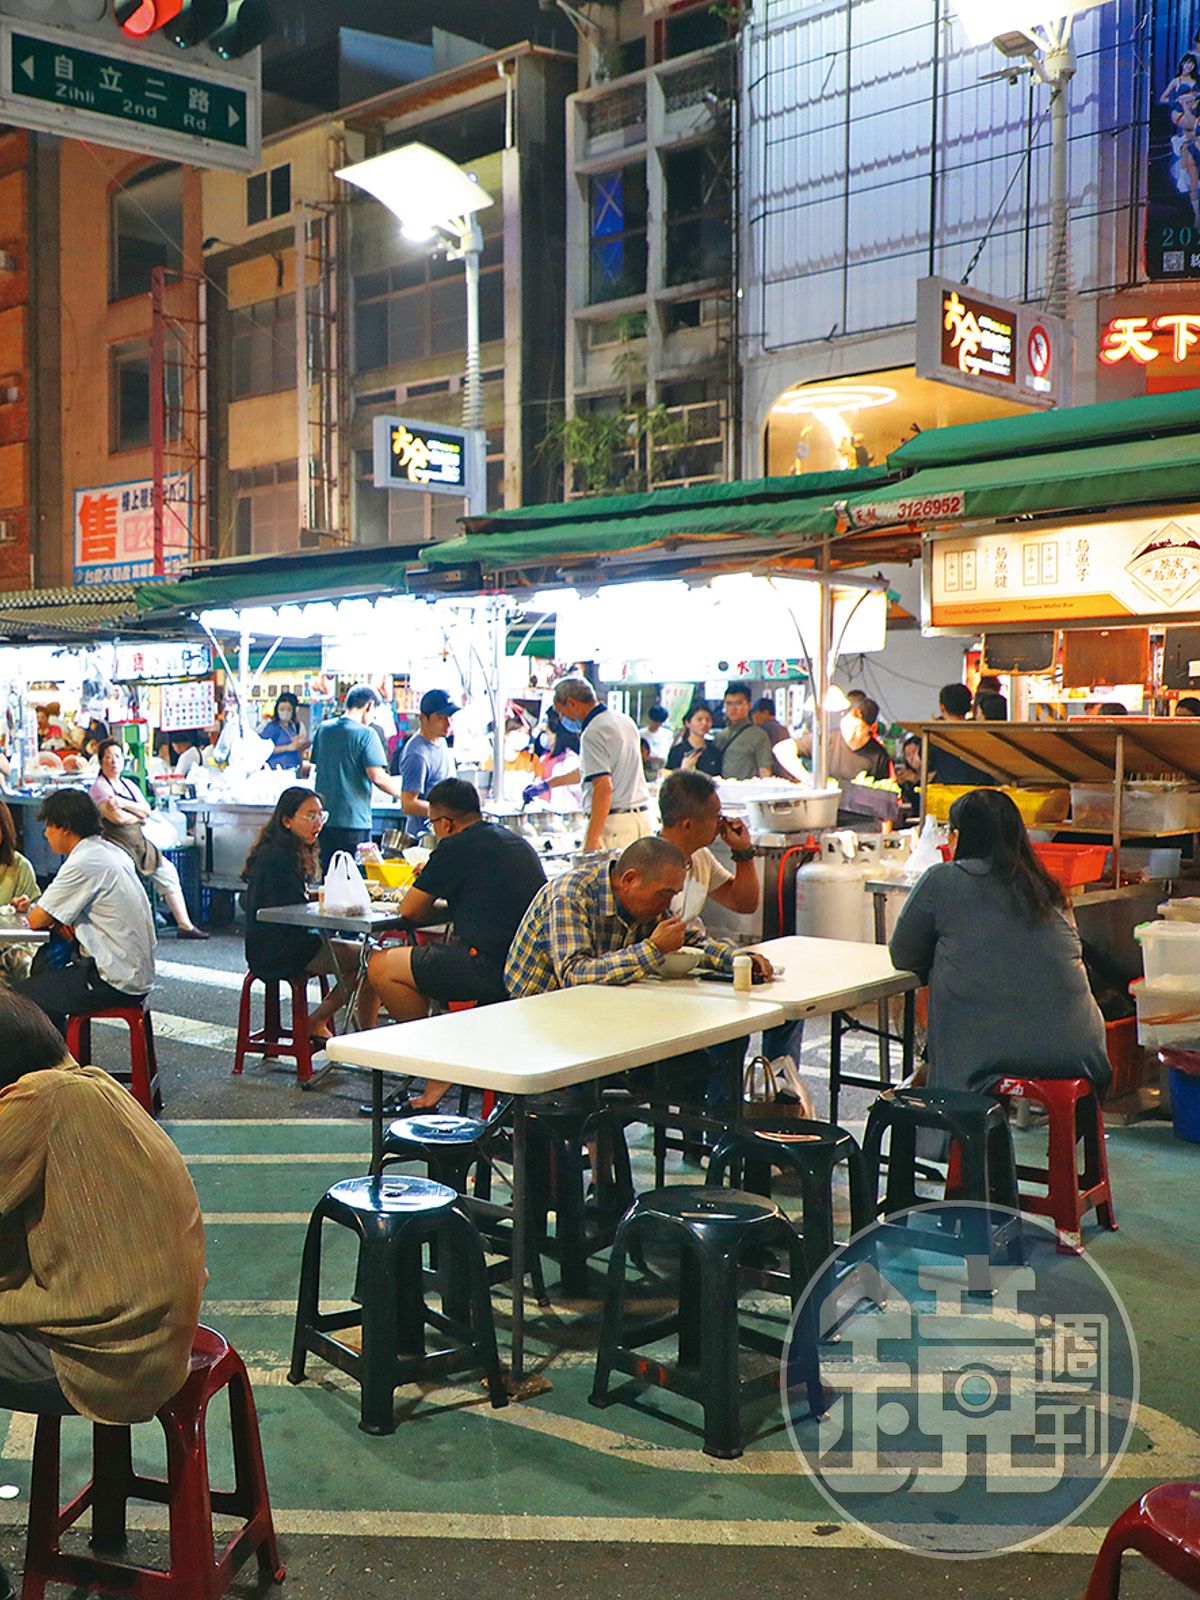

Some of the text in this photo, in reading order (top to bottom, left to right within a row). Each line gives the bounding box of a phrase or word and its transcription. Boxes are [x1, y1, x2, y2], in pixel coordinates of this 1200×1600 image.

[54, 54, 210, 115] 自立二路
[55, 83, 95, 105] Zihli
[123, 99, 158, 119] 2nd
